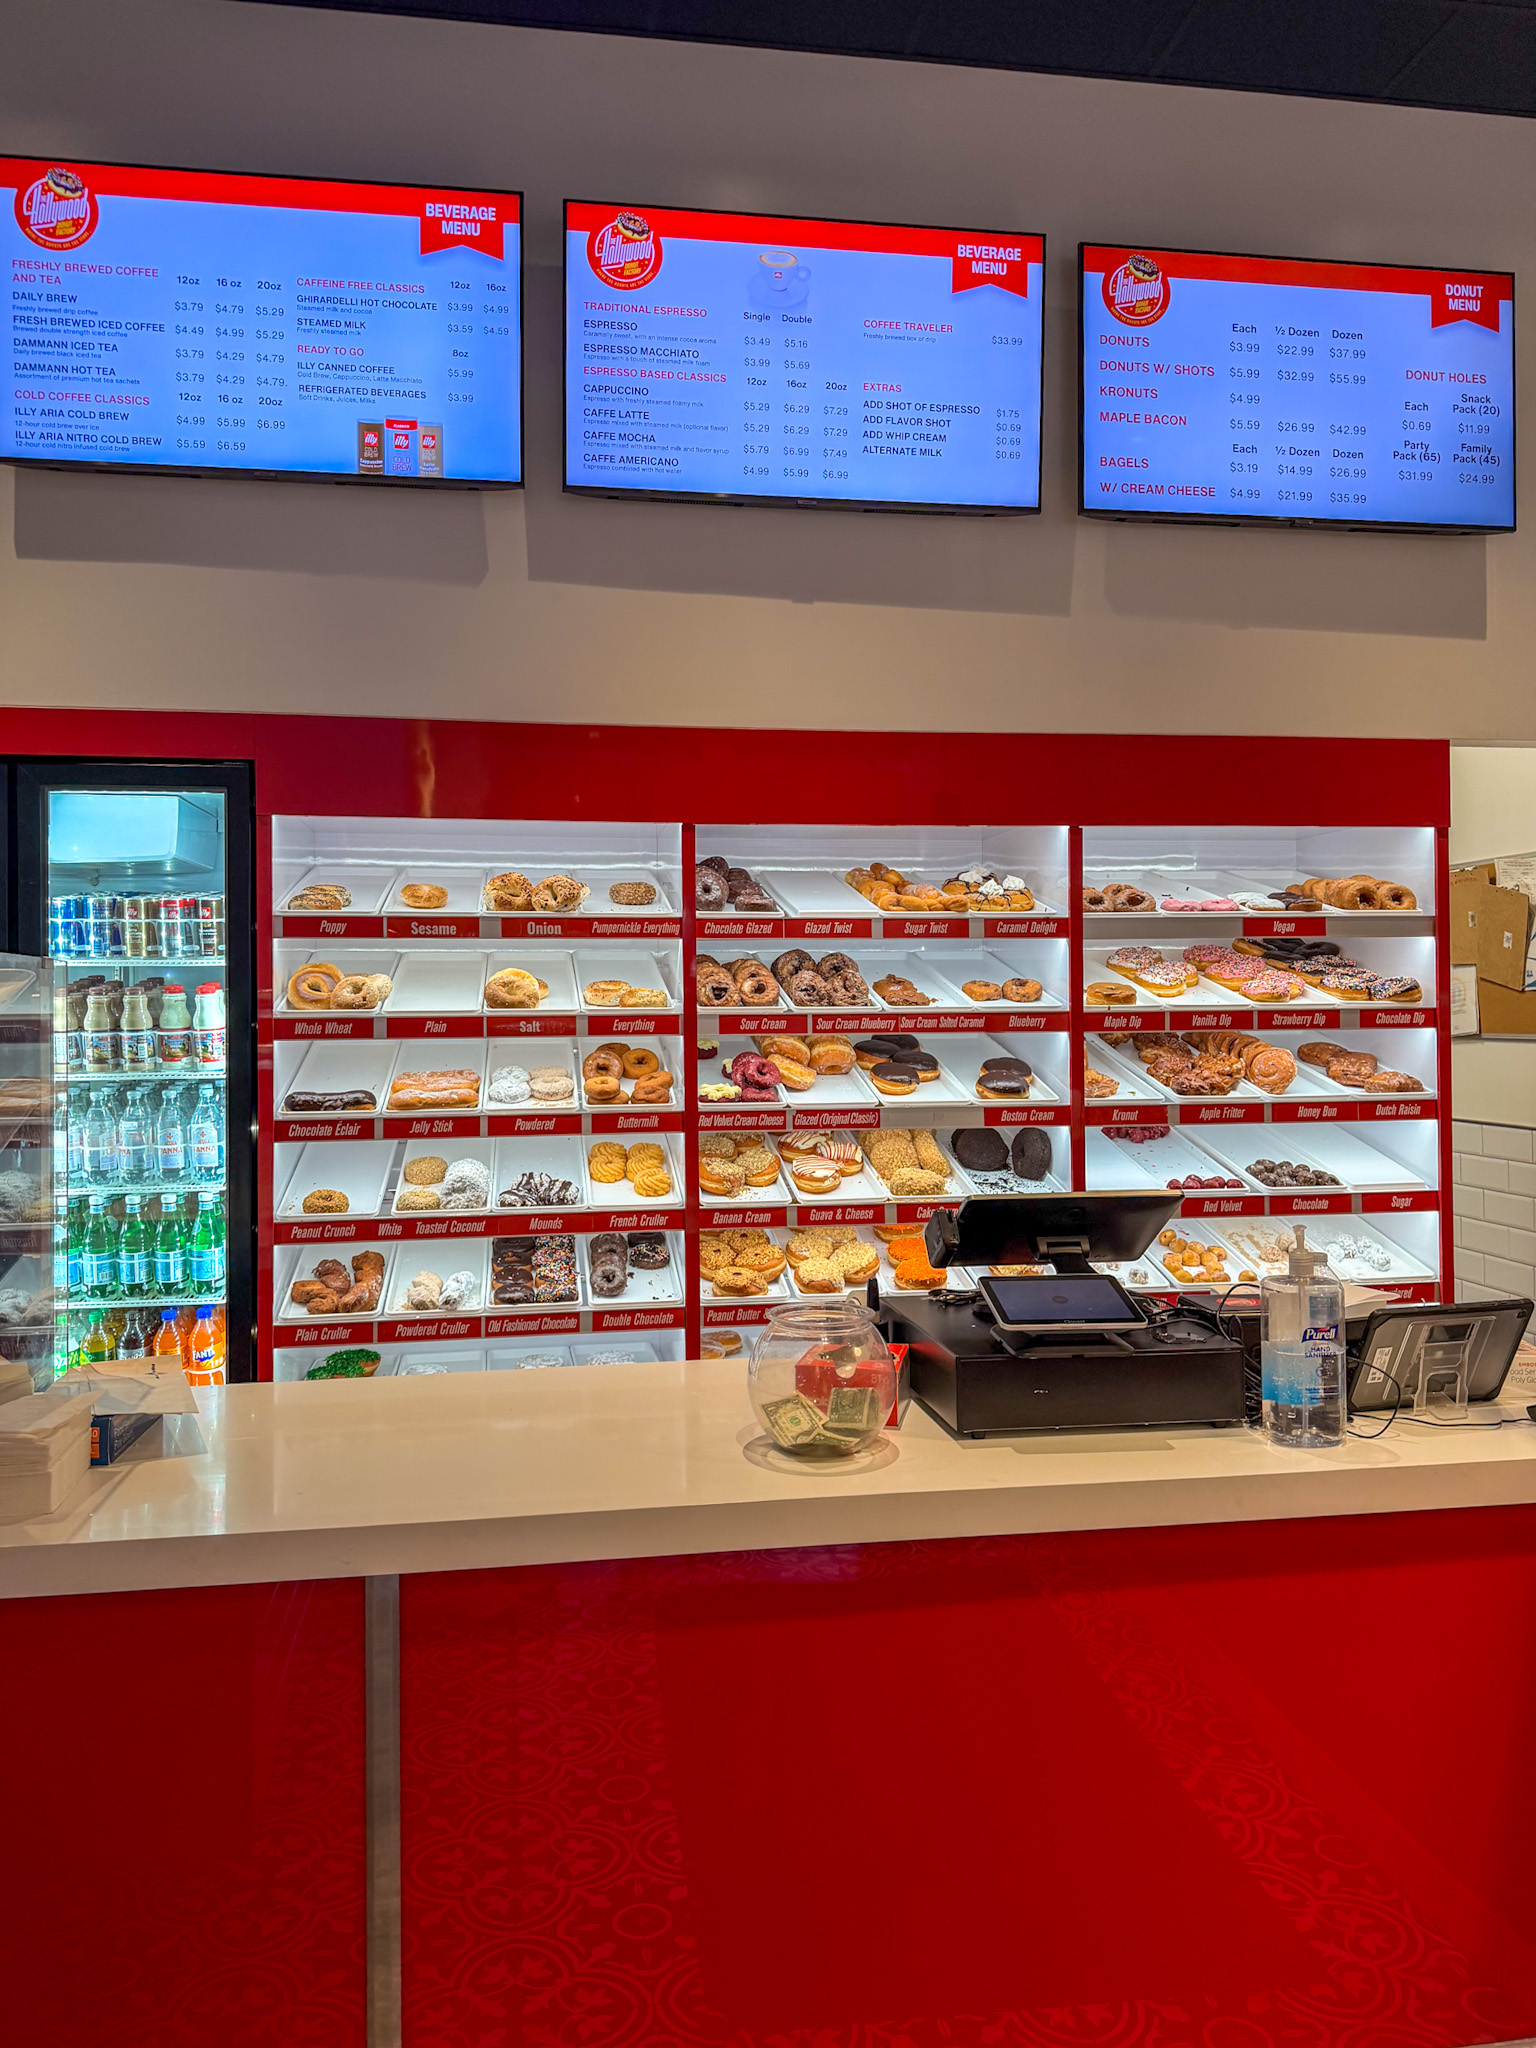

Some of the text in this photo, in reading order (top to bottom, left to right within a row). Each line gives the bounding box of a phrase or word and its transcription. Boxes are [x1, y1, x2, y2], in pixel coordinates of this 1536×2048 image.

[426, 203, 496, 221] BEVERAGE
[442, 221, 480, 236] MENU
[957, 245, 1021, 261] BEVERAGE
[12, 260, 158, 278] FRESHLY BREWED COFFEE
[972, 261, 1007, 275] MENU
[12, 274, 62, 285] AND TEA
[177, 276, 200, 285] 12oz
[216, 278, 227, 287] 16
[257, 281, 281, 290] 20oz
[297, 278, 425, 294] CAFFEINE FREE CLASSICS
[450, 282, 507, 292] 12oz 16oz
[1445, 284, 1483, 298] DONUT
[12, 291, 77, 304] DAILY BREW
[297, 295, 437, 311] GHIRARDELLI HOT CHOCOLATE
[12, 305, 36, 313] Freshly
[62, 308, 75, 316] drip
[175, 301, 284, 317] $3.79 $4.79 $5.29
[447, 303, 509, 314] $3.99 $4.99
[584, 302, 707, 318] TRADITIONAL ESPRESSO
[1448, 298, 1480, 312] MENU
[13, 315, 165, 332] FRESH BREWED ICED COFFEE
[743, 312, 812, 324] Single Double
[864, 319, 953, 333] COFFEE TRAVELER
[1232, 324, 1257, 334] Each
[1289, 328, 1319, 338] Dozen
[1332, 330, 1363, 340] Dozen
[744, 337, 808, 348] $3.49 $5.16
[864, 332, 883, 340] Freshly
[992, 336, 1023, 345] $33.99
[1100, 335, 1150, 348] DONUTS
[297, 345, 364, 356] READY TO GO
[584, 343, 699, 359] ESPRESSO MACCHIATO
[1229, 342, 1366, 359] $3.99 $22.99 $37.99
[1406, 370, 1487, 384] DONUT HOLES
[583, 384, 649, 396] CAPPUCCINO
[863, 383, 902, 393] EXTRAS
[1100, 386, 1158, 399] KRONUTS
[1461, 394, 1491, 404] Snack
[1405, 402, 1428, 411] Each
[1453, 405, 1500, 417] Pack (20)
[583, 408, 649, 420] CAFFE LATTE
[1100, 412, 1187, 426] MAPLE BACON
[863, 415, 952, 428] ADD FLAVOR SHOT
[996, 423, 1021, 432] $0.69
[1402, 421, 1490, 434] $0.69 $11.99
[1100, 456, 1149, 469] BAGELS
[1100, 482, 1215, 497] W/ CREAM CHEESE
[320, 920, 346, 935] Poppy
[411, 922, 457, 936] Sesame
[527, 921, 561, 935] Onion
[592, 921, 680, 936] Pumpernickle Everything
[904, 922, 948, 935] Sugar Twist
[1273, 921, 1296, 933] Vegan
[900, 1015, 985, 1029] Sour Cream Salted Caramel
[1009, 1015, 1046, 1029] Blueberry
[1104, 1015, 1142, 1029] Maple Dip
[1273, 1013, 1326, 1027] Strawberry Dip
[1376, 1011, 1425, 1025] Chocolate Dip
[294, 1022, 353, 1035] Whole Wheat
[424, 1020, 447, 1033] Plain
[519, 1020, 541, 1033] Salt
[612, 1018, 655, 1033] Everything
[1001, 1109, 1055, 1122] Boston Cream
[1112, 1109, 1138, 1121] Kronut
[1297, 1105, 1338, 1119] Honey Bun
[1375, 1103, 1421, 1116] Dutch Raisin
[515, 1117, 555, 1131] Powdered
[617, 1115, 659, 1130] Buttermilk
[699, 1114, 784, 1128] Red Velvet Cream Cheese
[794, 1112, 878, 1127] Glazed (Original Classic)
[288, 1120, 361, 1137] Chocolate Éclair
[410, 1120, 453, 1134] Jelly Stick
[1292, 1198, 1329, 1211] Chocolate
[1391, 1196, 1413, 1209] Sugar
[610, 1213, 668, 1228] French Cruller
[713, 1211, 771, 1225] Banana Cream
[810, 1207, 874, 1221] Guava & Cheese
[291, 1223, 356, 1239] Peanut Crunch
[415, 1219, 486, 1234] Toasted Coconut
[529, 1217, 563, 1231] Mounds
[602, 1311, 674, 1327] Double Chocolate
[707, 1308, 761, 1322] Peanut Butter
[1306, 1328, 1336, 1340] Purell
[192, 1349, 215, 1361] FANTA
[1511, 1376, 1525, 1384] Poly
